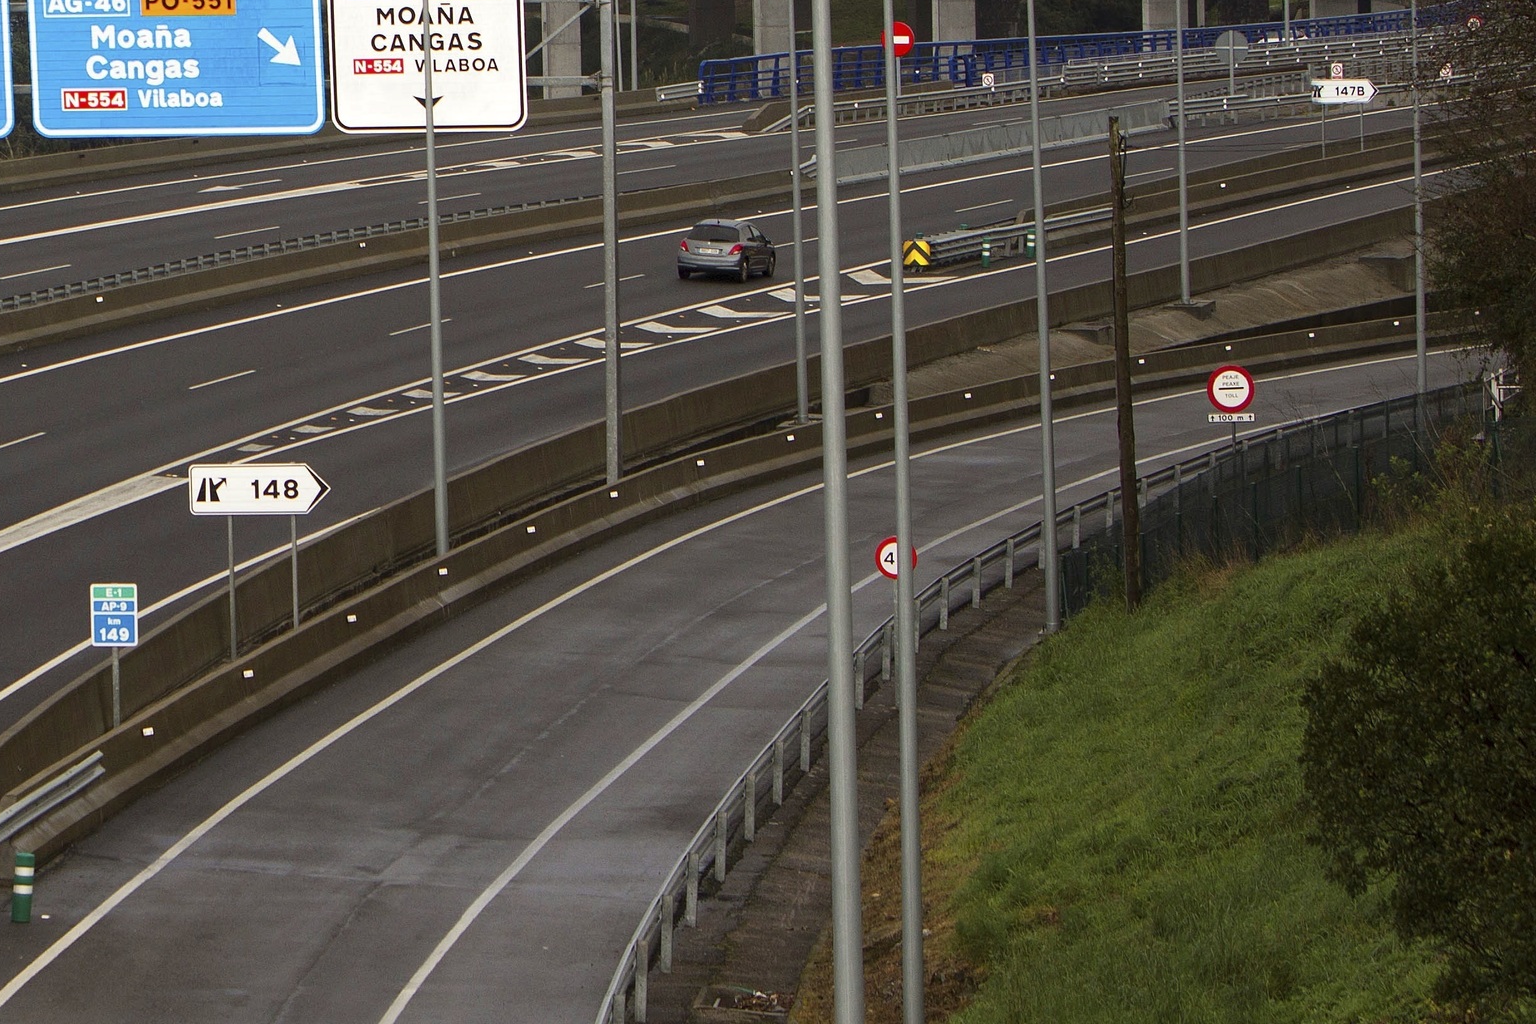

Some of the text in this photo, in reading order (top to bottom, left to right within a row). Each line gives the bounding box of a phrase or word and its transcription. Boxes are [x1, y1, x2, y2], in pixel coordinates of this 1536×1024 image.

[90, 25, 192, 49] Moaña
[371, 32, 482, 51] CANGAS
[85, 55, 200, 85] Cangas
[355, 58, 499, 72] N-554 VLABOA
[1335, 86, 1365, 96] 147B
[64, 89, 223, 108] N-554 Vilaboa
[251, 479, 299, 499] 148
[106, 588, 122, 597] E-1
[101, 602, 127, 611] AP-9
[107, 617, 121, 625] km
[100, 627, 129, 641] 149
